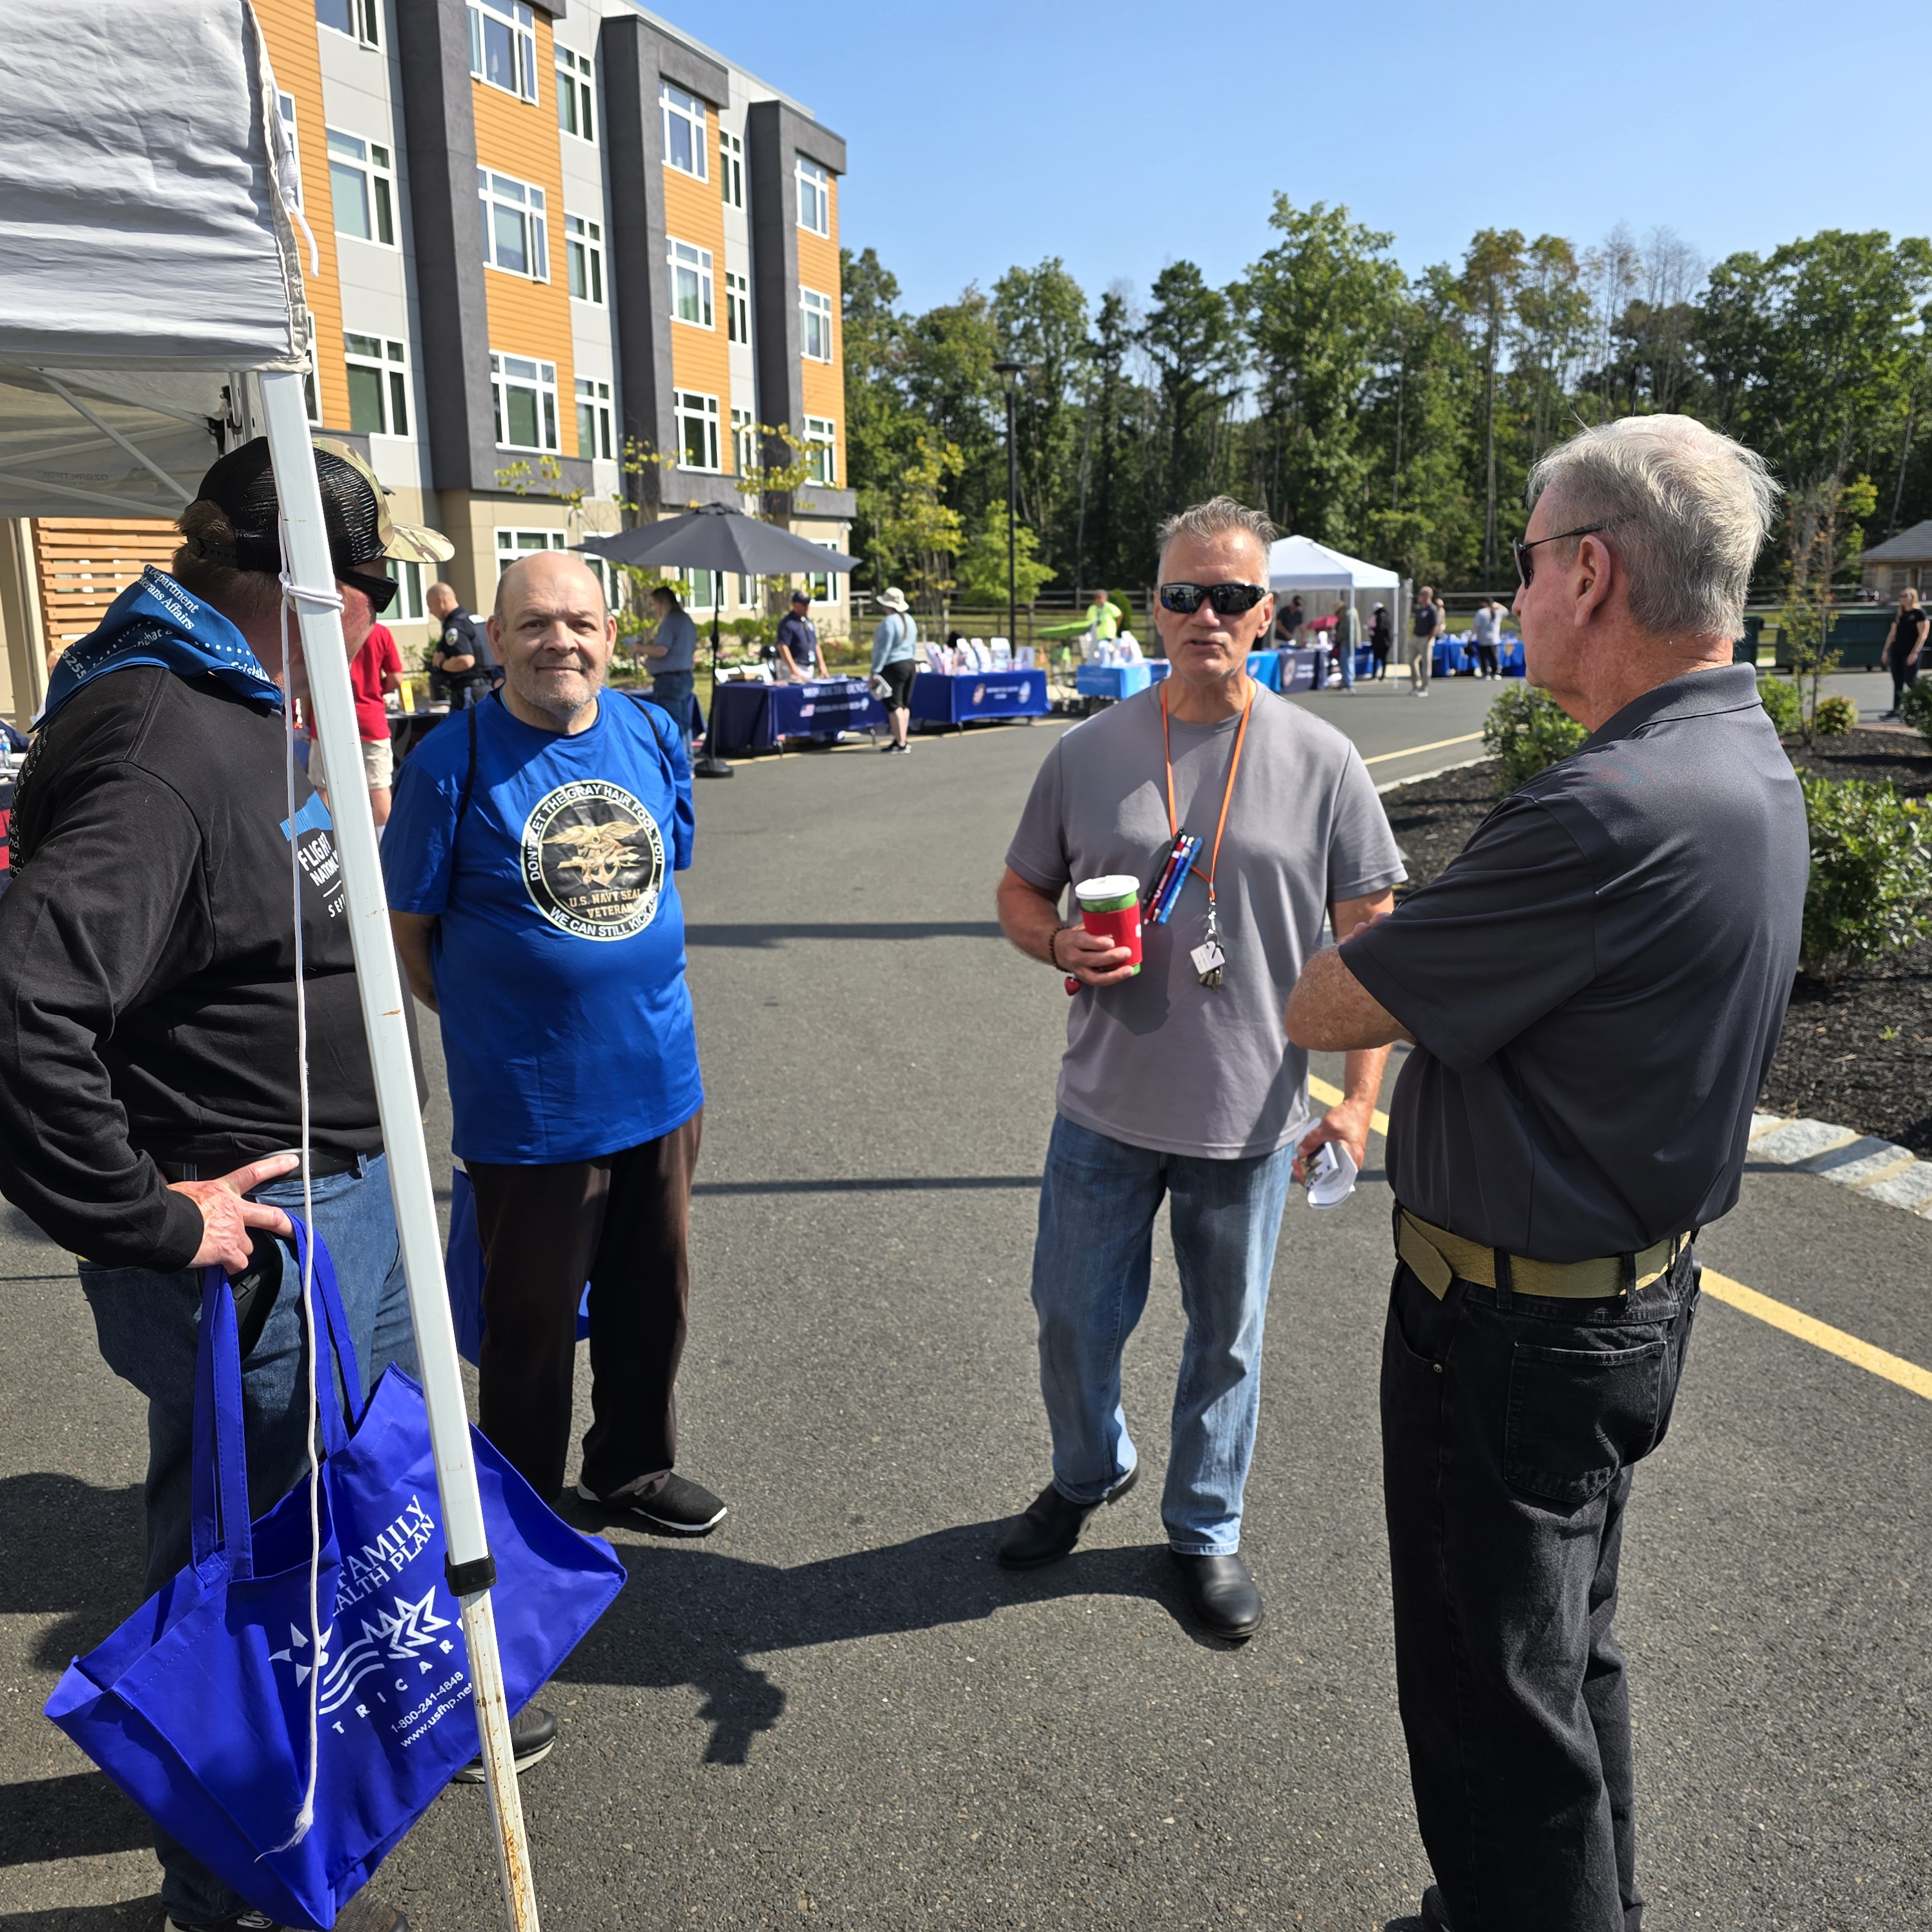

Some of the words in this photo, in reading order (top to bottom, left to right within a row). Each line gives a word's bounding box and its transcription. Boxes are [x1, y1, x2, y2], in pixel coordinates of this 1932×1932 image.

[149, 569, 199, 613] Department
[161, 598, 195, 630] Affairs
[542, 793, 567, 815] THE
[566, 784, 602, 799] GRAY
[604, 785, 632, 807] HAIR
[632, 803, 655, 836] FOOL
[652, 836, 663, 865] YOU
[569, 896, 590, 907] U.S.
[591, 890, 619, 905] NAVY
[621, 889, 642, 901] SEAL
[586, 902, 635, 919] VETERAN
[550, 906, 570, 926] WE
[570, 920, 597, 936] CAN
[598, 923, 630, 937] STILL
[628, 909, 650, 930] KICK
[337, 1494, 426, 1590] FAMILY
[389, 1514, 435, 1573] PLAN
[391, 1671, 464, 1733] 1-800-241-4848
